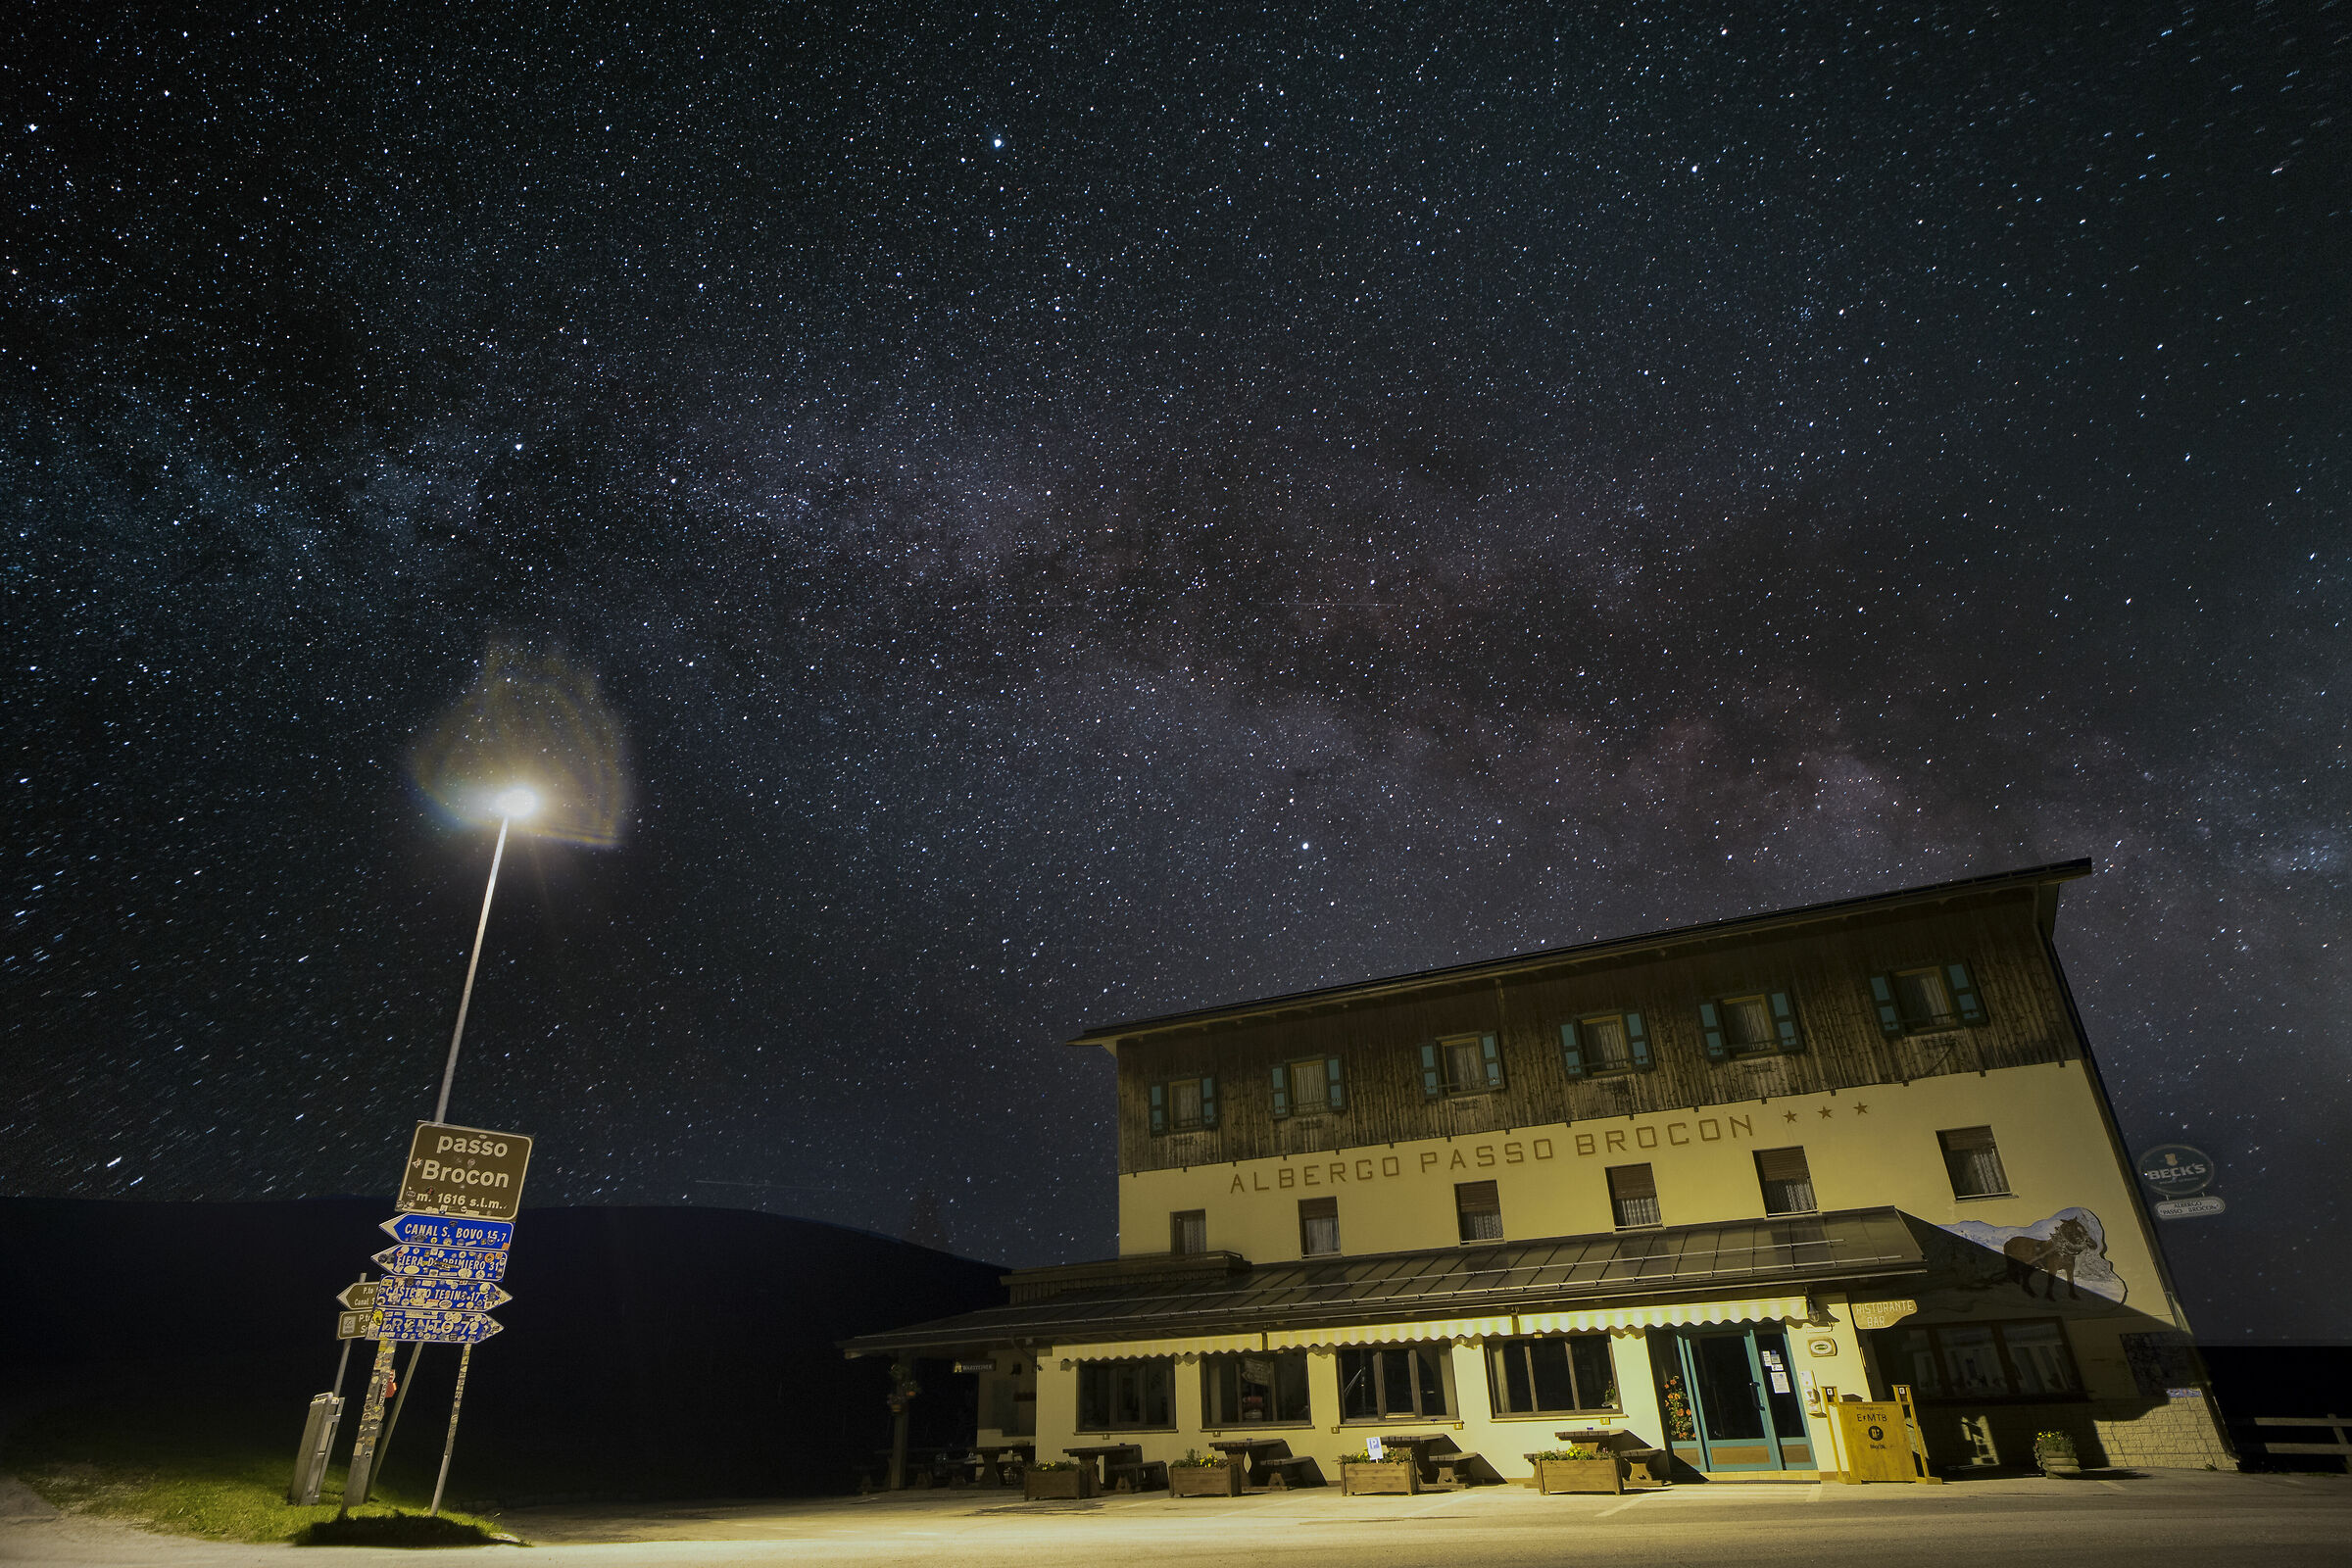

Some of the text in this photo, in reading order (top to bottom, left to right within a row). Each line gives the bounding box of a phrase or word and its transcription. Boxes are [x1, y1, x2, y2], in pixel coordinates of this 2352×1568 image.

[436, 1135, 508, 1157] passo
[1230, 1114, 1753, 1194] ALBERGO PASSO BROCON
[421, 1159, 509, 1188] Brocon
[416, 1193, 432, 1202] m.
[438, 1193, 466, 1205] 1616
[405, 1223, 438, 1237] CANAL
[441, 1227, 451, 1238] S.
[456, 1228, 483, 1240] BOVO
[397, 1255, 423, 1266] FIERA
[489, 1261, 500, 1271] 31
[386, 1286, 431, 1299] CASTEO
[434, 1289, 467, 1301] TESIN
[1856, 1300, 1914, 1314] RISTORANTE
[460, 1321, 479, 1335] 72
[1867, 1316, 1886, 1328] BAR
